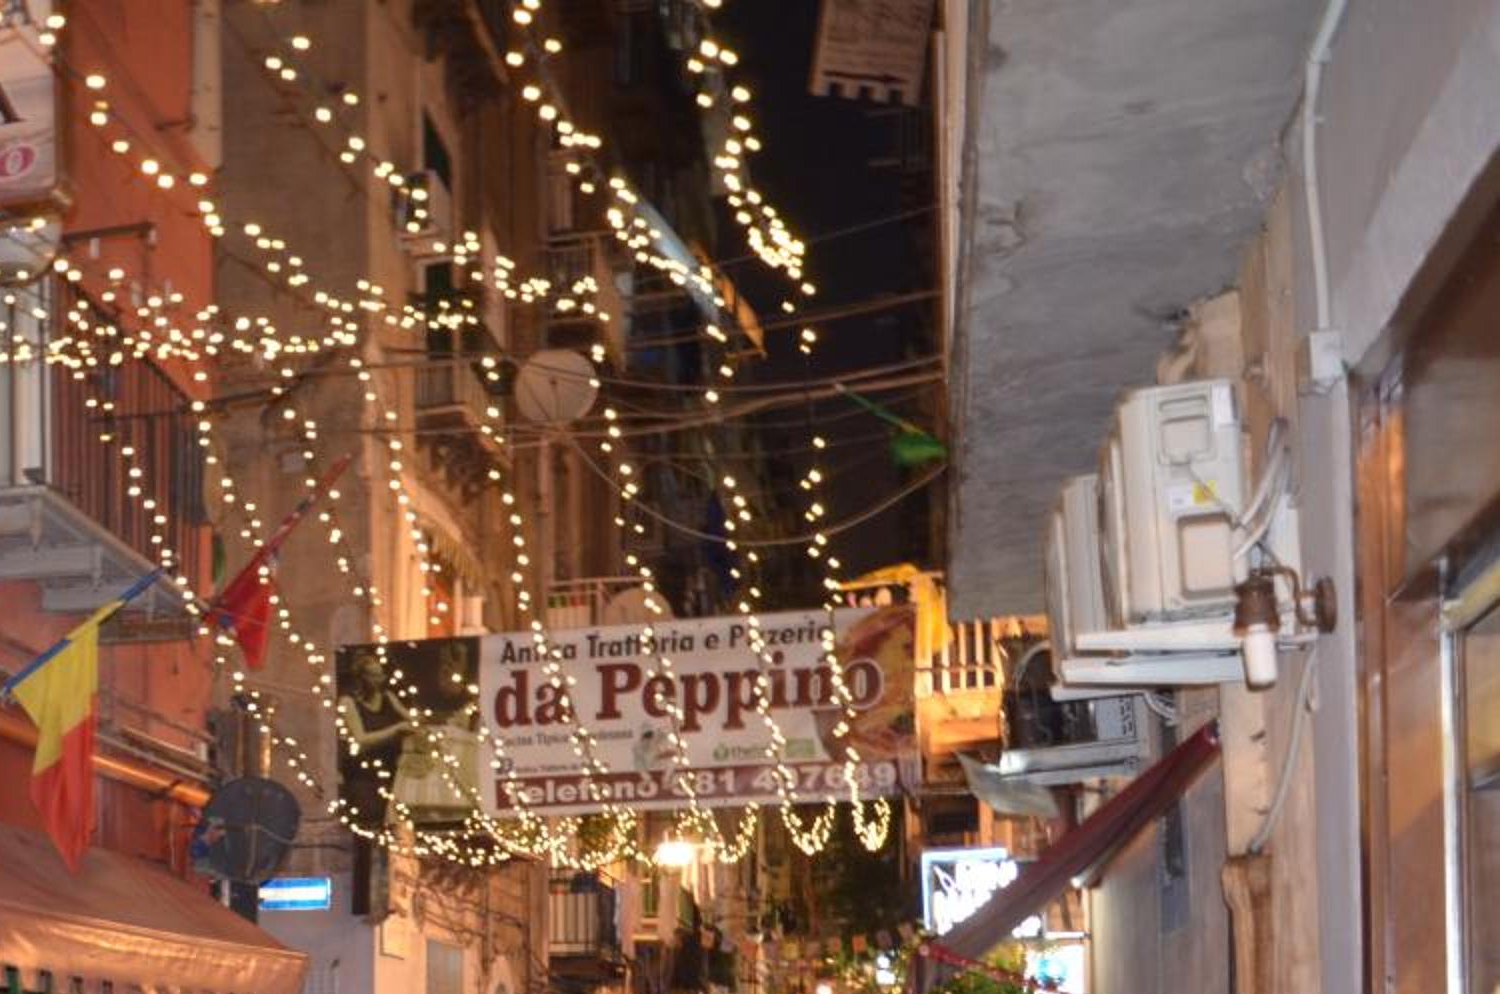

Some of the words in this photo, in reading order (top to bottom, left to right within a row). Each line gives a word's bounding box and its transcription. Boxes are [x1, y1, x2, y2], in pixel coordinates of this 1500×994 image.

[704, 632, 719, 650] e
[729, 621, 835, 649] Pzeria
[494, 669, 573, 729] da
[595, 650, 885, 734] Peppino
[501, 777, 659, 806] Telefono
